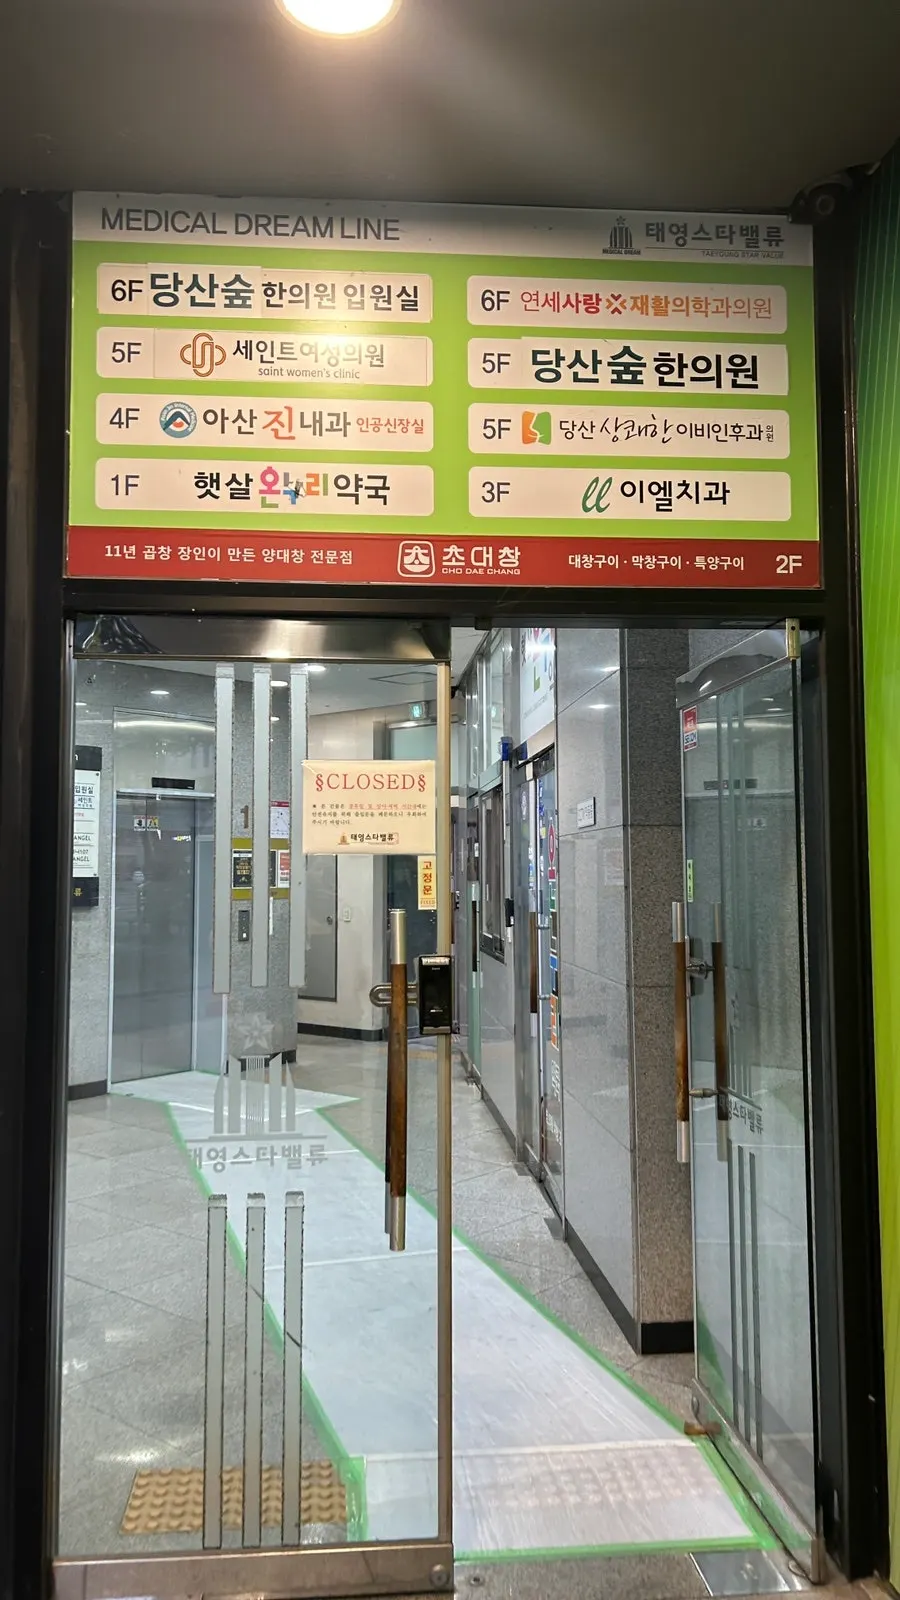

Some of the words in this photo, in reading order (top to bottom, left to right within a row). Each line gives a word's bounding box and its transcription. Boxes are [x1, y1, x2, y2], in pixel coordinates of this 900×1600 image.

[101, 208, 227, 234] MEDICAL
[234, 213, 333, 238] DREAM
[340, 217, 400, 240] LINE
[646, 222, 785, 248] 태영스타밸류
[111, 280, 143, 301] 6F
[343, 284, 418, 311] 입원실
[481, 289, 510, 311] 6F
[630, 294, 772, 319] 재활의학과의원
[111, 342, 142, 363] 5F
[233, 340, 384, 368] 세인트여성의원
[482, 353, 511, 373] 5F
[258, 367, 284, 376] saint
[287, 368, 330, 378] women's
[333, 368, 360, 379] clinic
[109, 407, 140, 429] 4F
[356, 417, 424, 434] 인공신장실
[482, 419, 512, 440] 5F
[677, 422, 763, 442] 이비인후과
[111, 474, 140, 496] 1F
[482, 481, 510, 503] 3F
[620, 480, 730, 513] 이엘치과
[105, 545, 136, 560] 11년
[143, 545, 172, 561] 곱창
[178, 546, 221, 562] 장인이
[227, 547, 256, 562] 만든
[262, 548, 305, 563] 양대창
[310, 550, 353, 565] 전문점
[442, 544, 521, 568] 초대창
[568, 555, 619, 569] 대창구이
[631, 555, 682, 570] 막창구이
[694, 556, 744, 571] 특양구이
[775, 555, 802, 574] 2F
[442, 567, 463, 575] CHO
[487, 568, 521, 576] CHANG
[350, 833, 394, 842] 태영스타밸류
